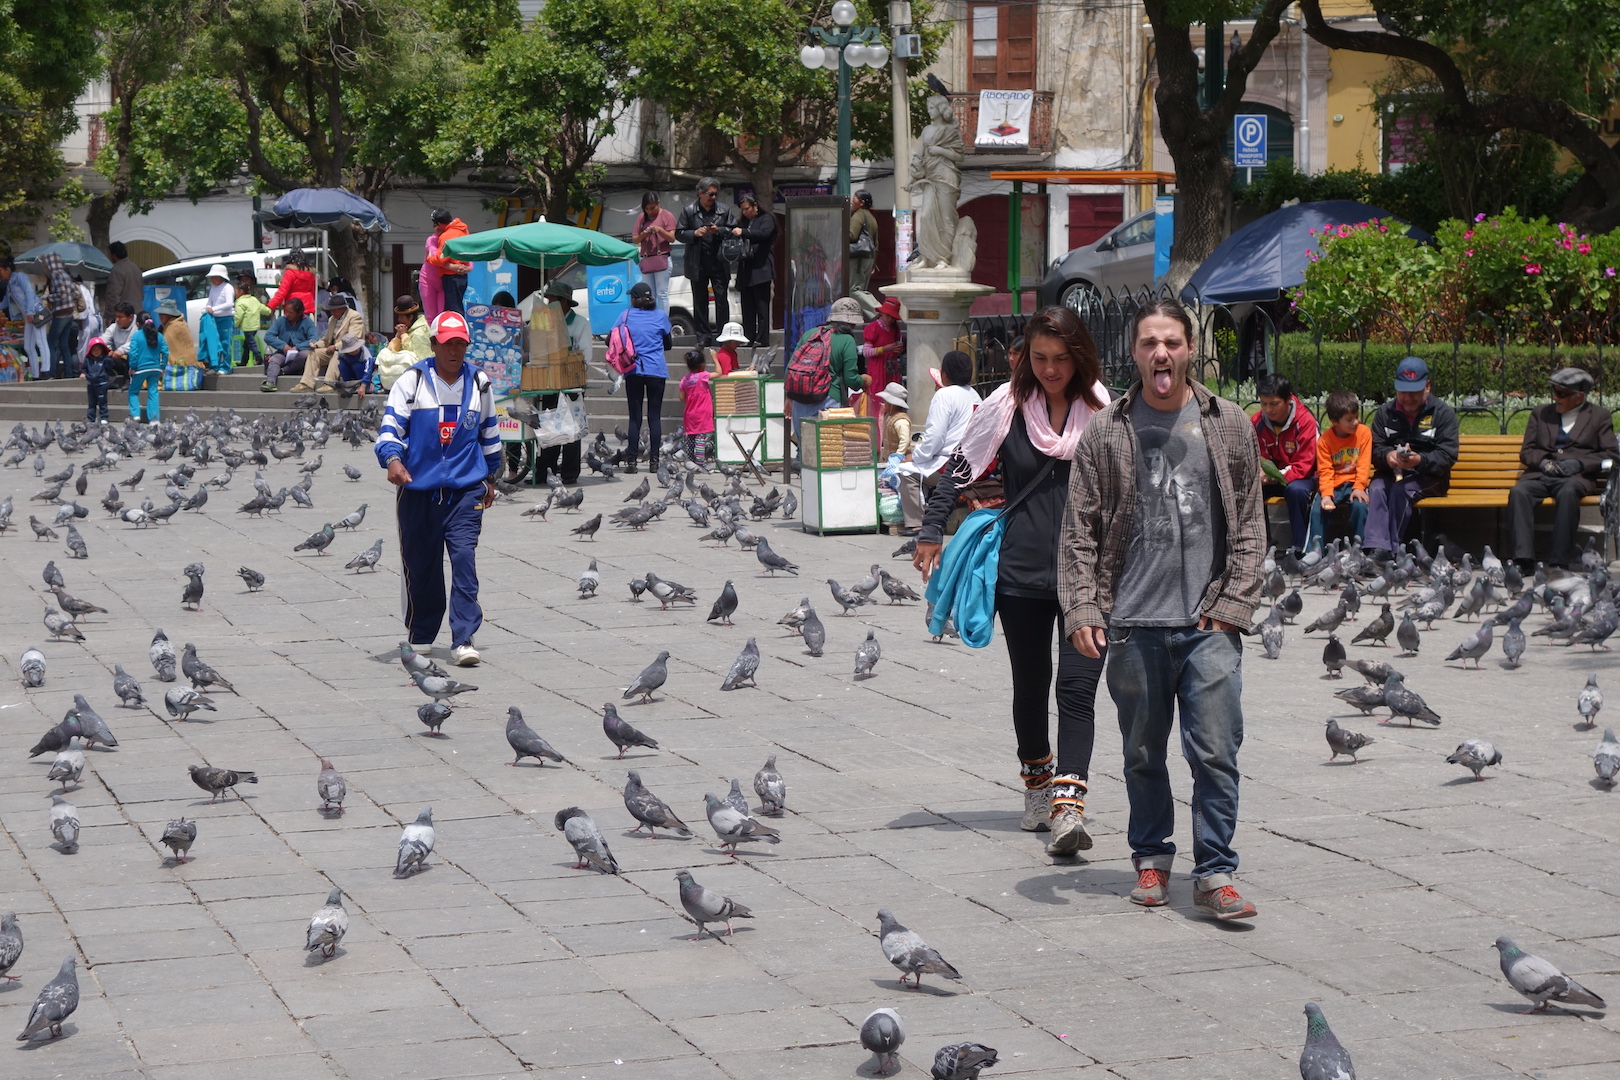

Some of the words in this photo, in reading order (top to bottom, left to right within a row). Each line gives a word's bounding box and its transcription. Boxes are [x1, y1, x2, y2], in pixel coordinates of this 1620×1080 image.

[982, 91, 1030, 100] ABOGADO
[1246, 123, 1257, 141] P
[596, 286, 615, 296] entel
